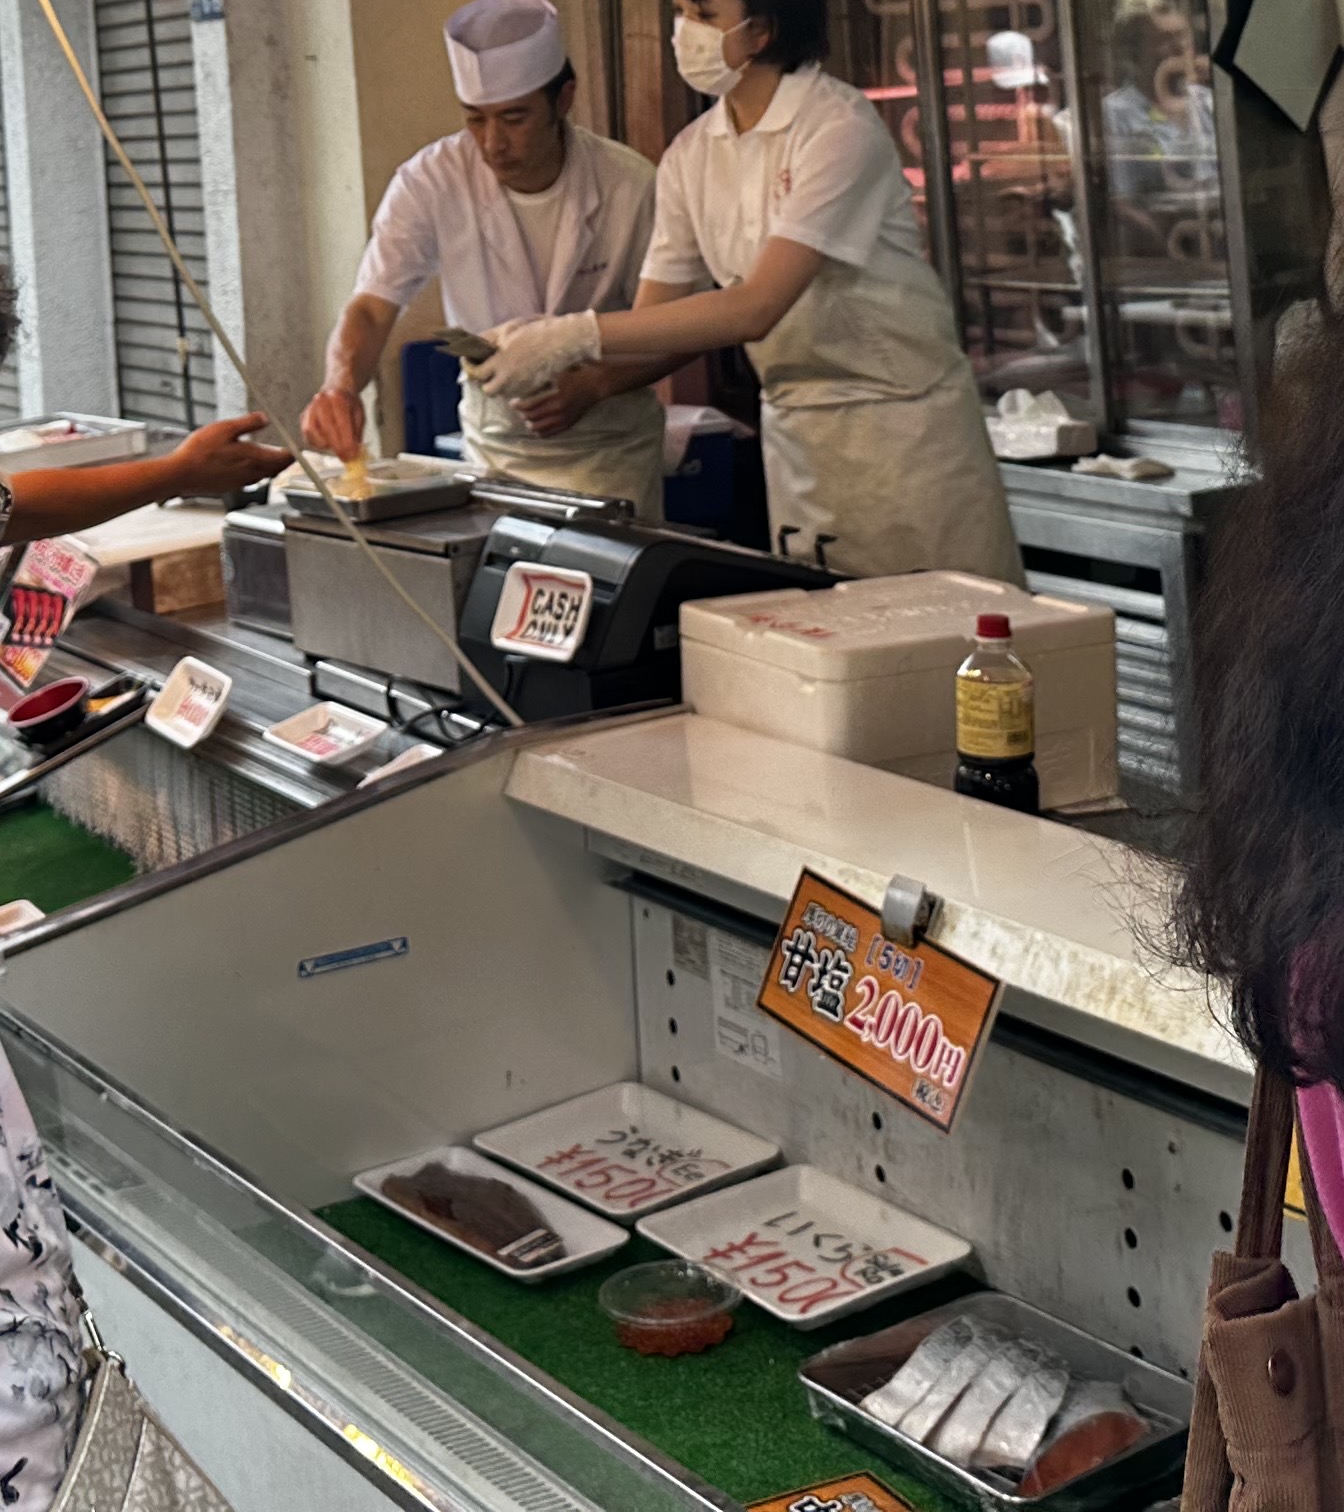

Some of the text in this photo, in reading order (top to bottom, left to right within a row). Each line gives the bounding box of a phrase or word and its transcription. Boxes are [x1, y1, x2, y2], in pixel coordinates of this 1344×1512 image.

[531, 588, 583, 622] CASH
[779, 928, 854, 1023] 甘塩
[844, 975, 966, 1087] 2,000円
